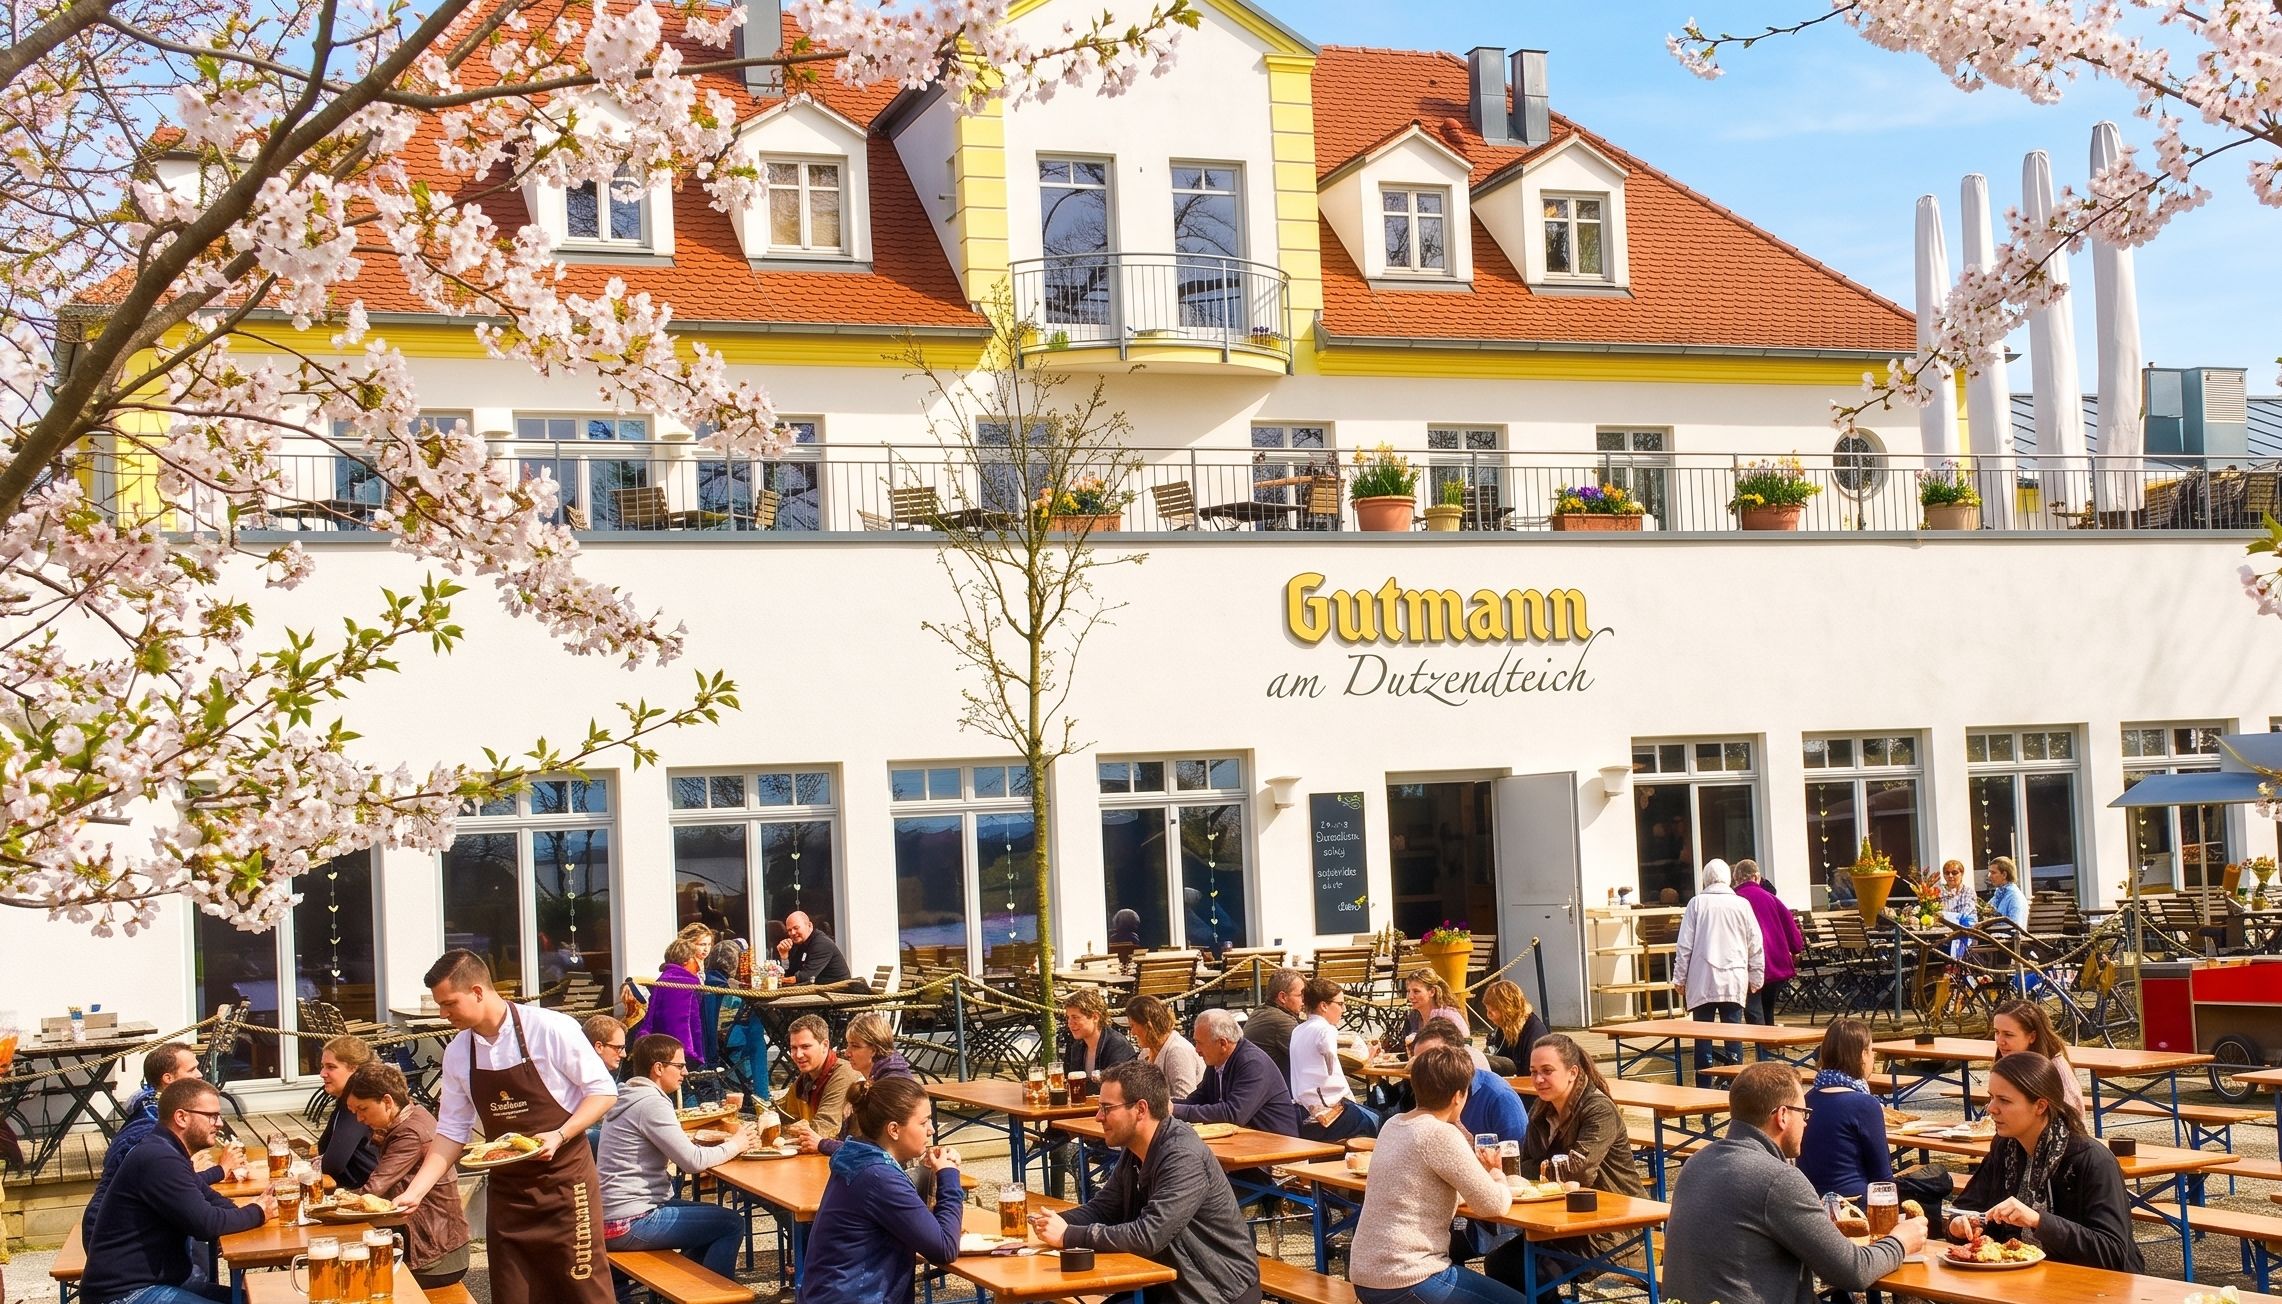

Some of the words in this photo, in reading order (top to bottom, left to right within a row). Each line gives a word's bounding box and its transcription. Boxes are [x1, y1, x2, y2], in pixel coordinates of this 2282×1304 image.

[1285, 572, 1594, 645] Gutmann
[1266, 671, 1326, 699] am
[1343, 626, 1615, 707] Dutzendteich
[570, 1182, 593, 1280] Gutmann
